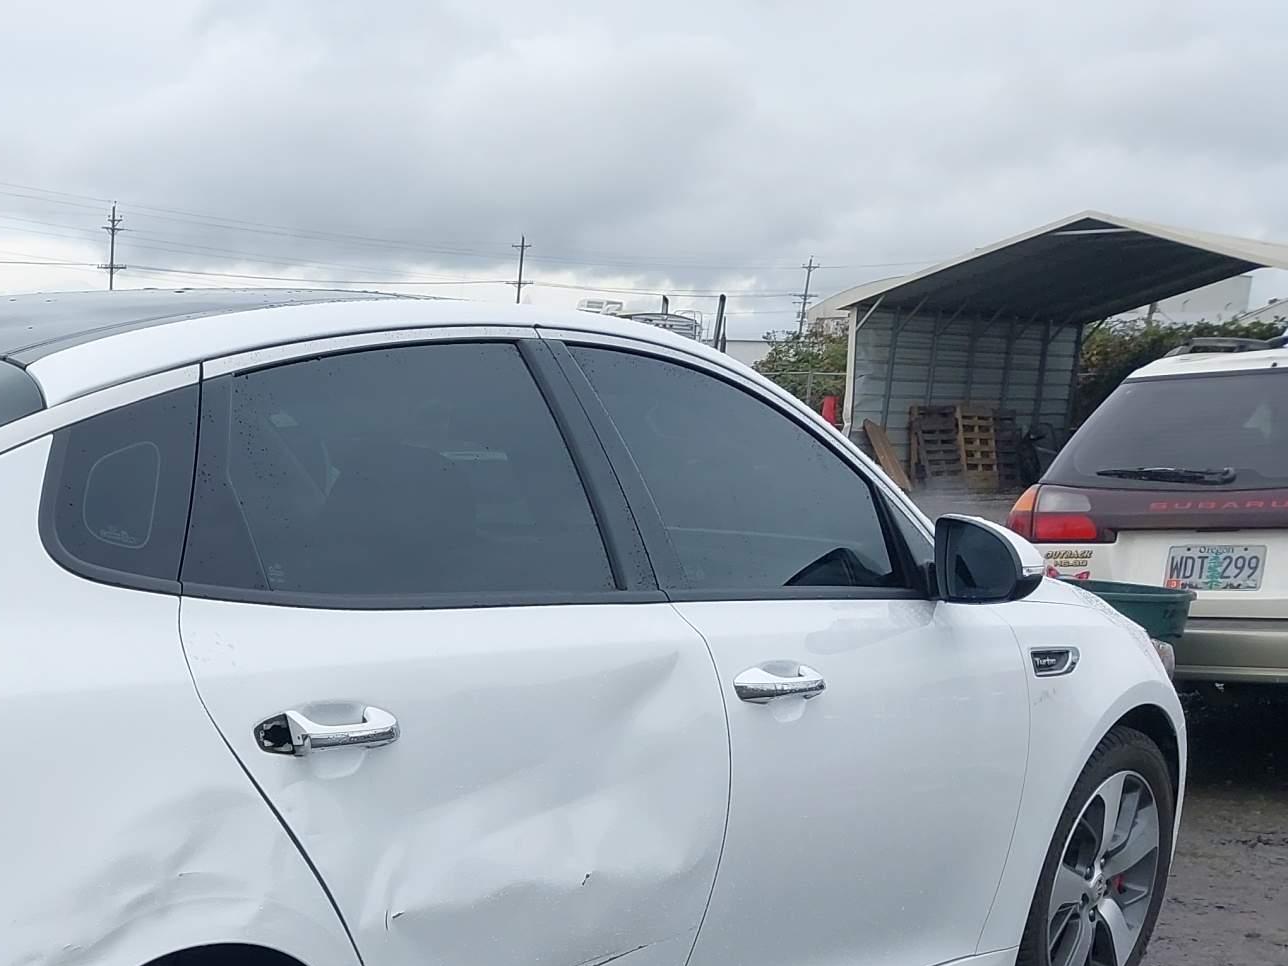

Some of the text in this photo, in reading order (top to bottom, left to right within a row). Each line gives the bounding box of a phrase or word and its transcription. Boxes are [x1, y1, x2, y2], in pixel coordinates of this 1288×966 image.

[1044, 550, 1094, 559] OUTBACK
[1199, 545, 1234, 555] Oregon
[1169, 555, 1260, 579] WDT 299
